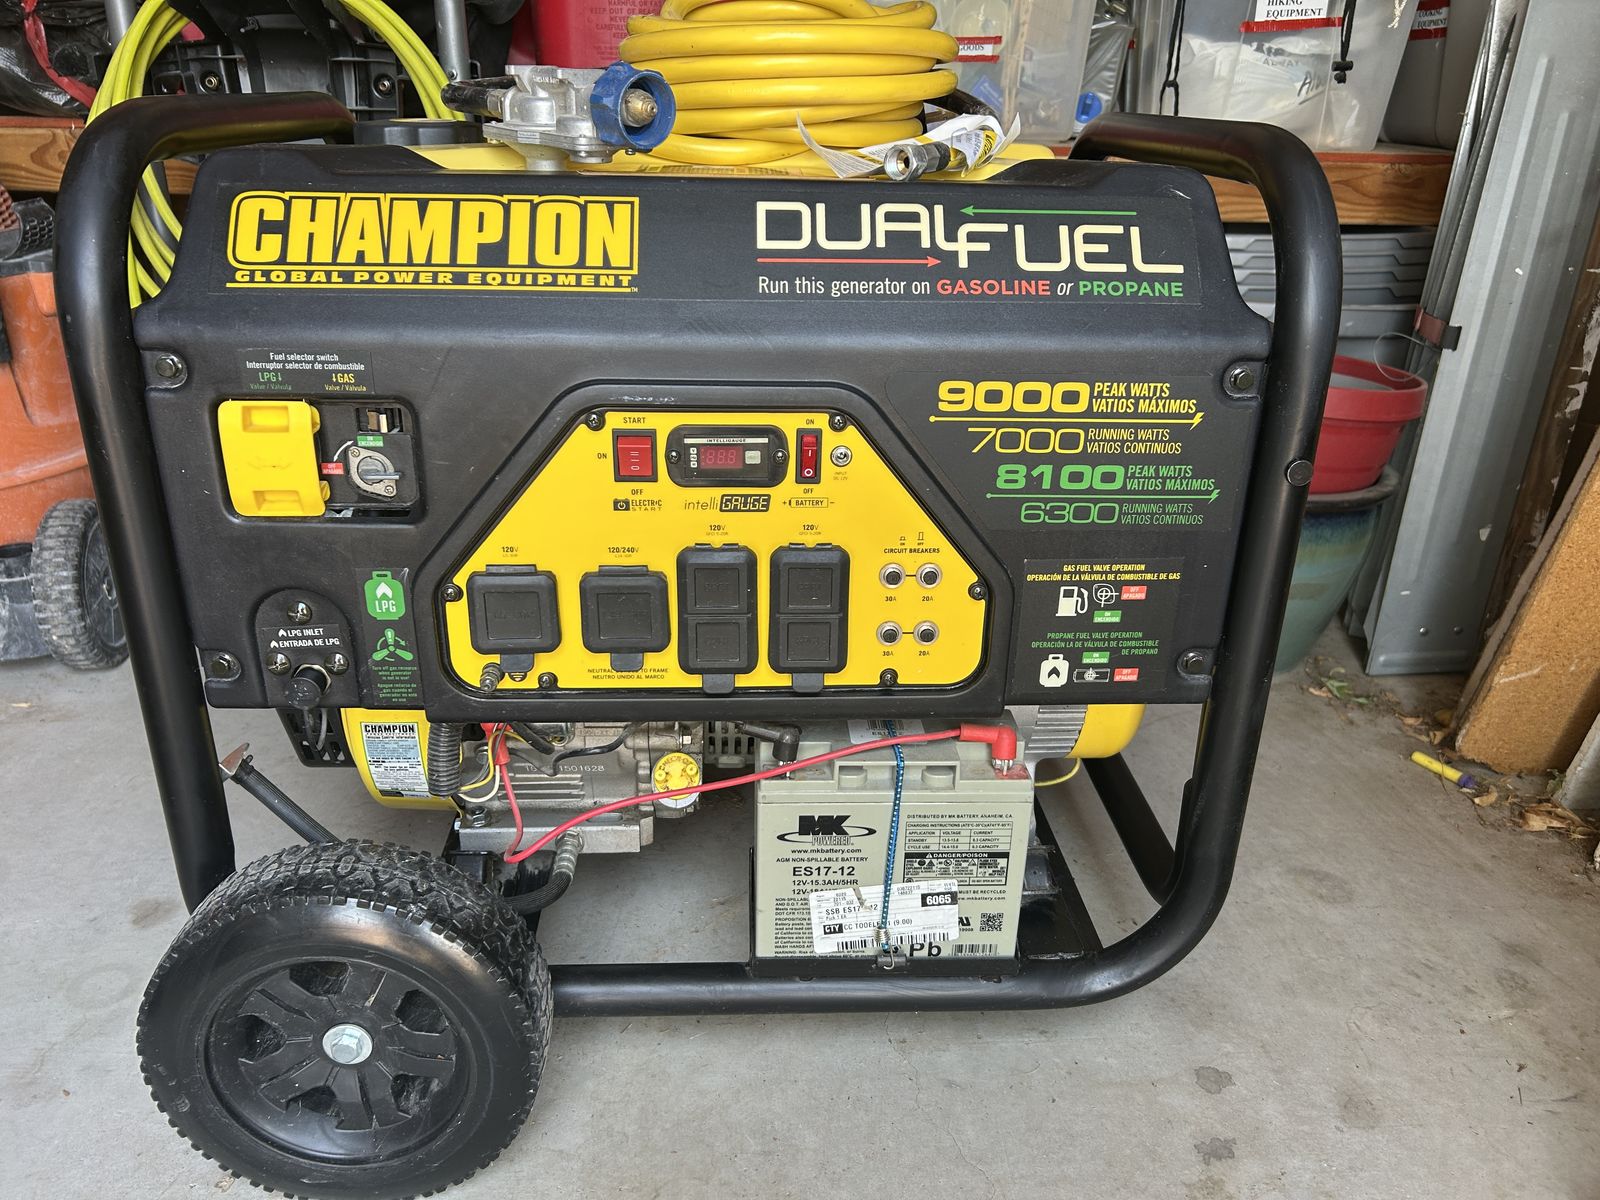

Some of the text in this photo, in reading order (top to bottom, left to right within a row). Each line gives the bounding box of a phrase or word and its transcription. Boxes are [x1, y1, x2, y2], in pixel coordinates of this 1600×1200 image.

[1266, 8, 1324, 18] EQUIPMENT
[232, 196, 633, 268] CHAMPION
[234, 270, 632, 287] GLOBAL POWER EQUIPMENT
[758, 276, 1184, 297] Run this generator on GASOLINE or PROPANE
[269, 352, 339, 361] Fuel selector switch
[246, 361, 365, 371] Interruptor selector de combustible
[259, 372, 276, 382] LPG
[337, 373, 355, 383] GAS
[1093, 382, 1171, 397] PEAK WATTS
[938, 380, 1091, 413] 9000
[1092, 396, 1197, 413] VATIOS MÁXIMOS
[1088, 428, 1170, 441] RUNNING WATTS
[967, 427, 1085, 454] 7000
[1086, 442, 1182, 454] VATIOS CONTINUOS
[1127, 465, 1193, 477] PEAK WATTS
[996, 464, 1125, 490] 8100
[1126, 476, 1216, 491] VATIOS MÁXIMOS
[631, 499, 662, 507] ELECTRIC
[1122, 503, 1194, 514] RUNNING WATTS
[1020, 502, 1120, 524] 6300
[1121, 514, 1204, 525] VATIOS CONTINUOS
[607, 546, 640, 554] 120/240V
[1026, 572, 1062, 581] OPERACIÓN
[1080, 572, 1106, 581] VÁLVULA
[1168, 572, 1181, 580] GAS
[375, 600, 397, 612] LPG
[287, 628, 324, 637] LPG INLET
[279, 637, 340, 648] ENTRADA DE LPG
[364, 724, 415, 733] CHAMPION
[798, 814, 852, 836] MK
[811, 835, 851, 846] POWERED
[792, 866, 855, 876] ES17-12
[926, 894, 952, 905] 6065
[825, 907, 840, 915] SSB
[909, 941, 942, 957] Pb
